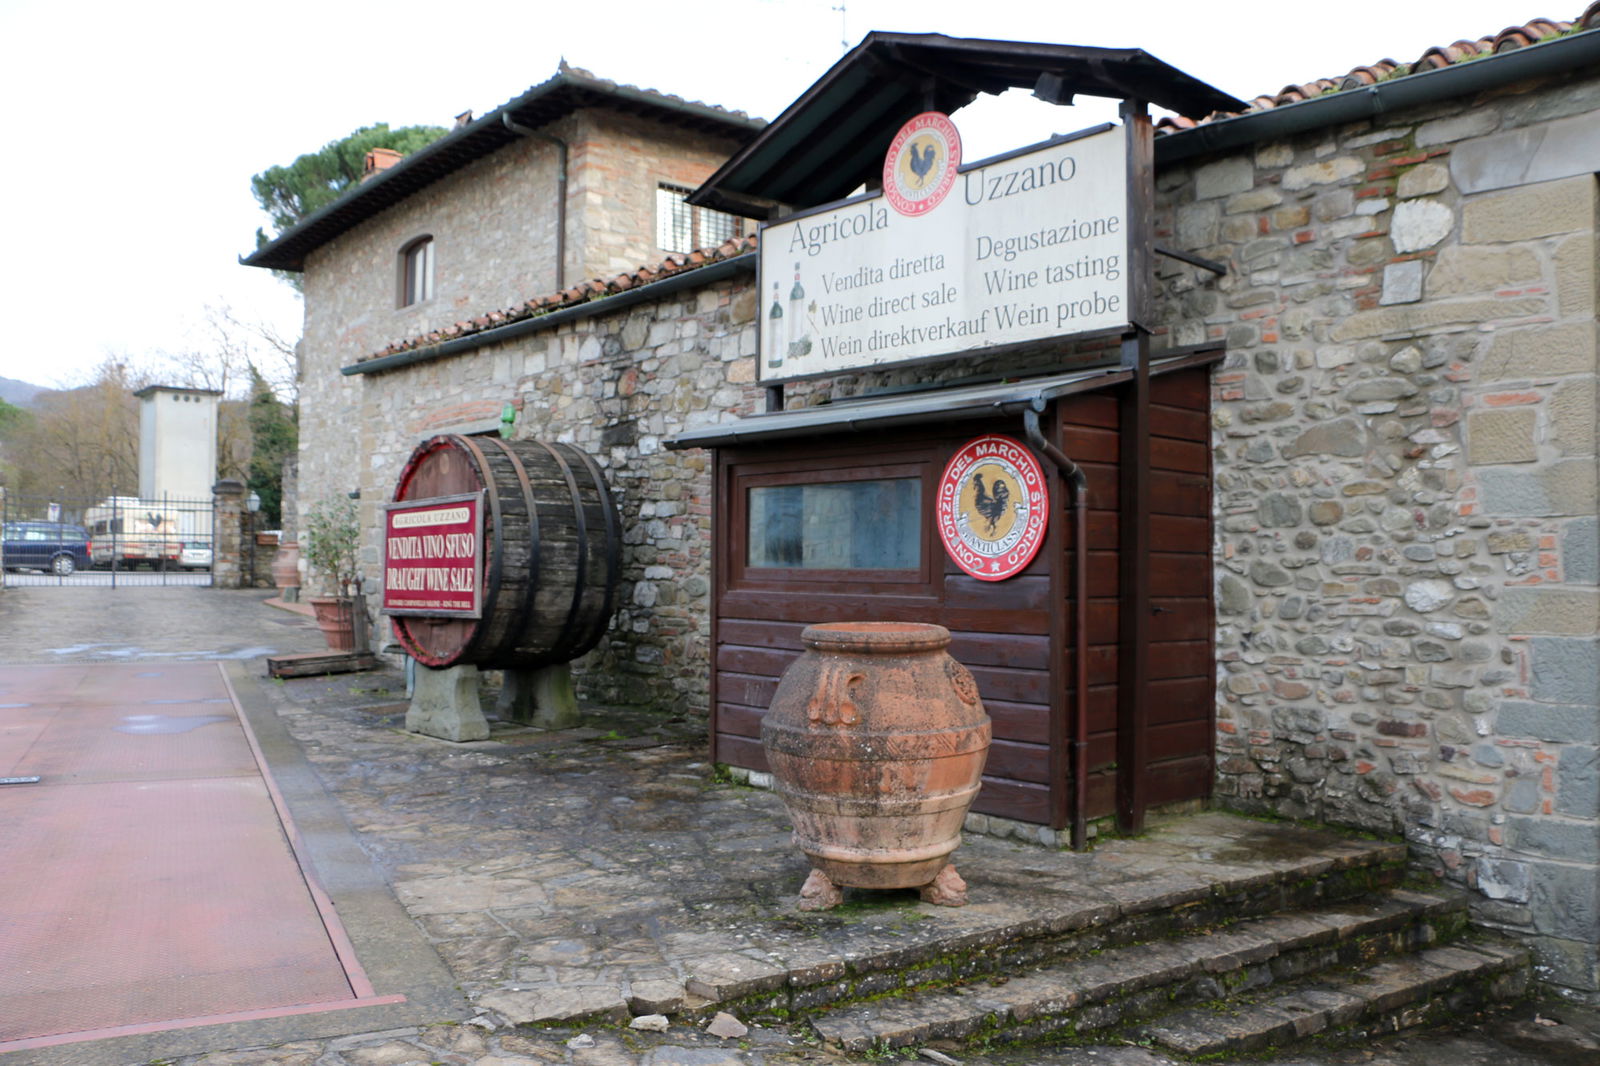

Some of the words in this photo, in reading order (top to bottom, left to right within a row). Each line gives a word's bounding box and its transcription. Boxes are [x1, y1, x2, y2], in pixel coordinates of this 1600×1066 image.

[788, 202, 889, 257] Agricola
[963, 155, 1077, 206] Uzzano
[976, 215, 1120, 263] Degustazione
[821, 266, 884, 295] Vendita
[889, 254, 945, 285] diretta
[984, 268, 1039, 296] Wine
[1045, 253, 1120, 284] tasting
[820, 303, 863, 327] Wine
[867, 293, 916, 320] direct
[921, 283, 958, 309] sale
[994, 301, 1050, 331] Wein
[1056, 291, 1121, 328] probe
[820, 336, 863, 359] Wein
[867, 310, 990, 352] direktverkauf
[950, 455, 974, 480] DEL
[975, 443, 1037, 486] MARCHIO
[434, 510, 467, 522] UZZANO
[942, 483, 985, 571] CONORZIO
[1007, 491, 1042, 565] STORICO
[388, 537, 422, 560] VENDITA
[423, 534, 445, 559] VINO
[446, 533, 475, 558] SFUSO
[387, 567, 426, 591] DRAUGHT
[426, 567, 450, 591] WINE
[451, 568, 474, 592] SALE
